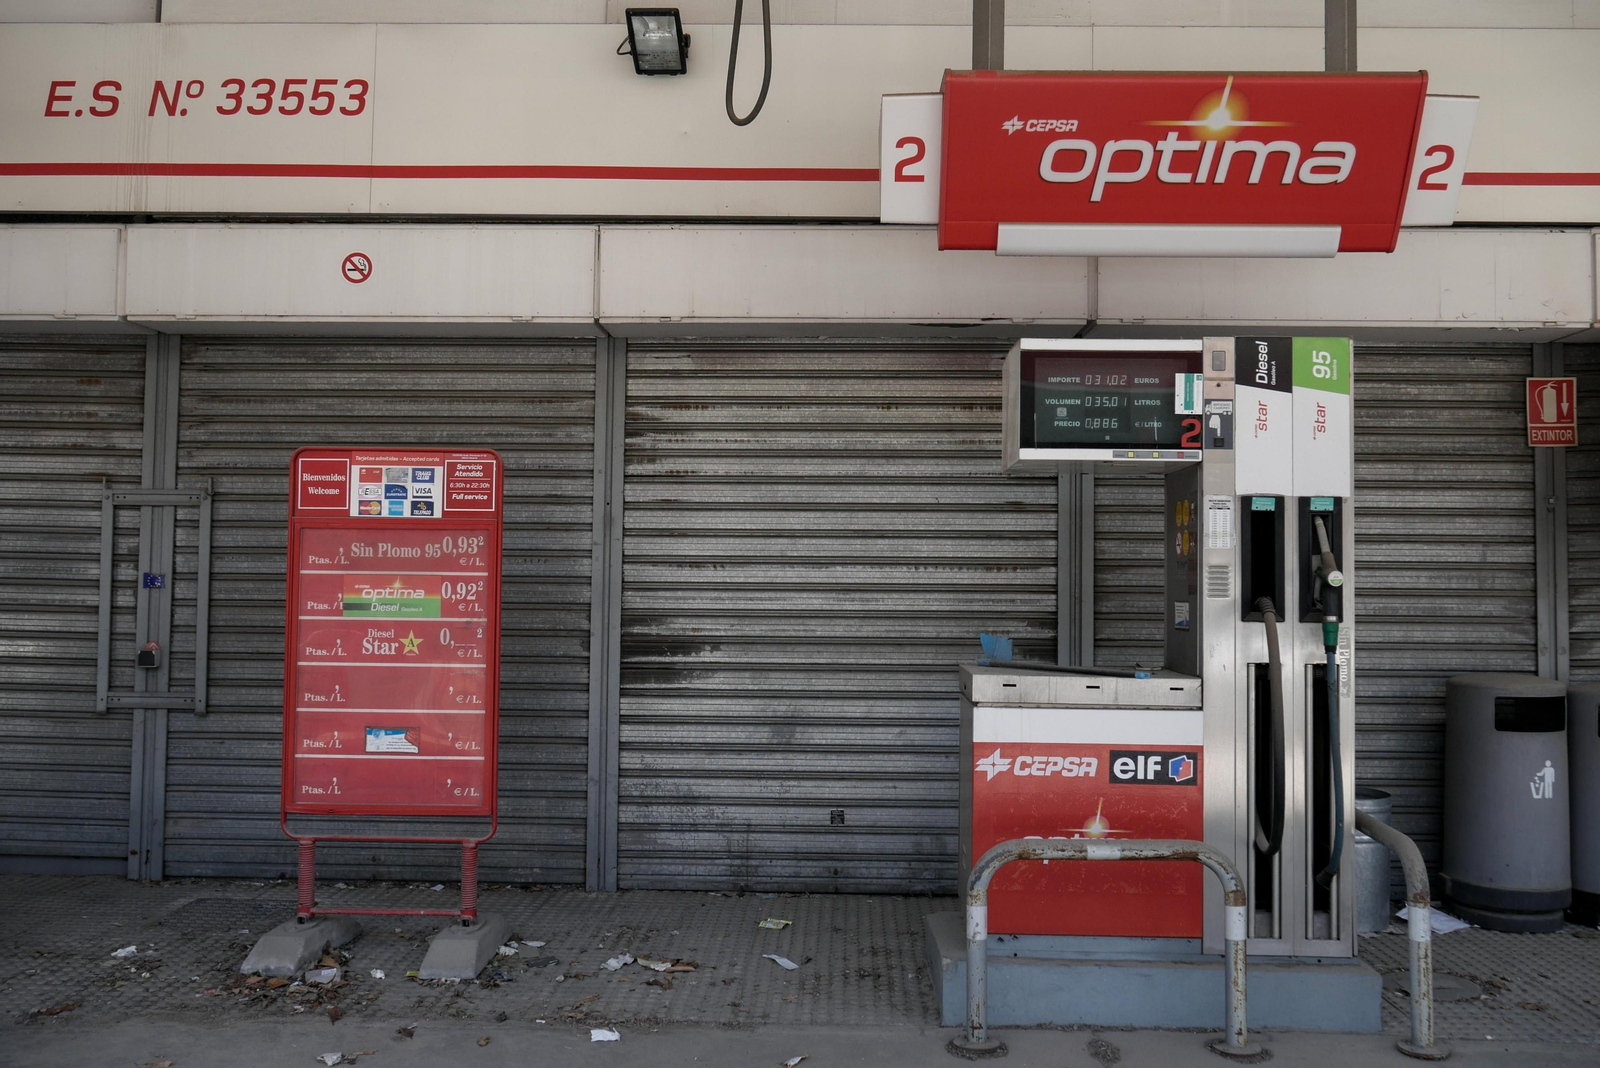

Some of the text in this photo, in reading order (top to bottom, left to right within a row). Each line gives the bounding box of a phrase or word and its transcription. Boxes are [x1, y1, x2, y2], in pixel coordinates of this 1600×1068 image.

[44, 80, 122, 117] E.S
[216, 78, 370, 117] 33553
[1025, 119, 1078, 132] CEPSA
[894, 136, 926, 183] 2
[1039, 131, 1356, 203] optima
[1417, 144, 1455, 191] 2
[1255, 341, 1268, 384] Diesel
[1312, 350, 1331, 379] 95
[1256, 400, 1268, 432] star
[1314, 402, 1326, 433] star
[1181, 418, 1202, 448] 2
[1531, 430, 1573, 441] EXTINTOR
[302, 473, 346, 481] Bienvenidos
[308, 487, 340, 495] Welcome
[351, 543, 440, 558] Sin Plomo 95
[308, 556, 332, 564] Ptas.
[362, 587, 425, 602] optima
[307, 602, 330, 610] Ptas.
[371, 603, 400, 612] Diesel
[368, 629, 394, 638] Diesel
[306, 648, 329, 656] Ptas.
[362, 638, 415, 655] Star A
[1339, 649, 1350, 682] Plomo
[304, 693, 328, 701] Ptas.
[303, 739, 326, 747] Ptas.
[1013, 755, 1098, 777] CEPSA
[1113, 755, 1162, 780] elf
[302, 786, 325, 794] Ptas.
